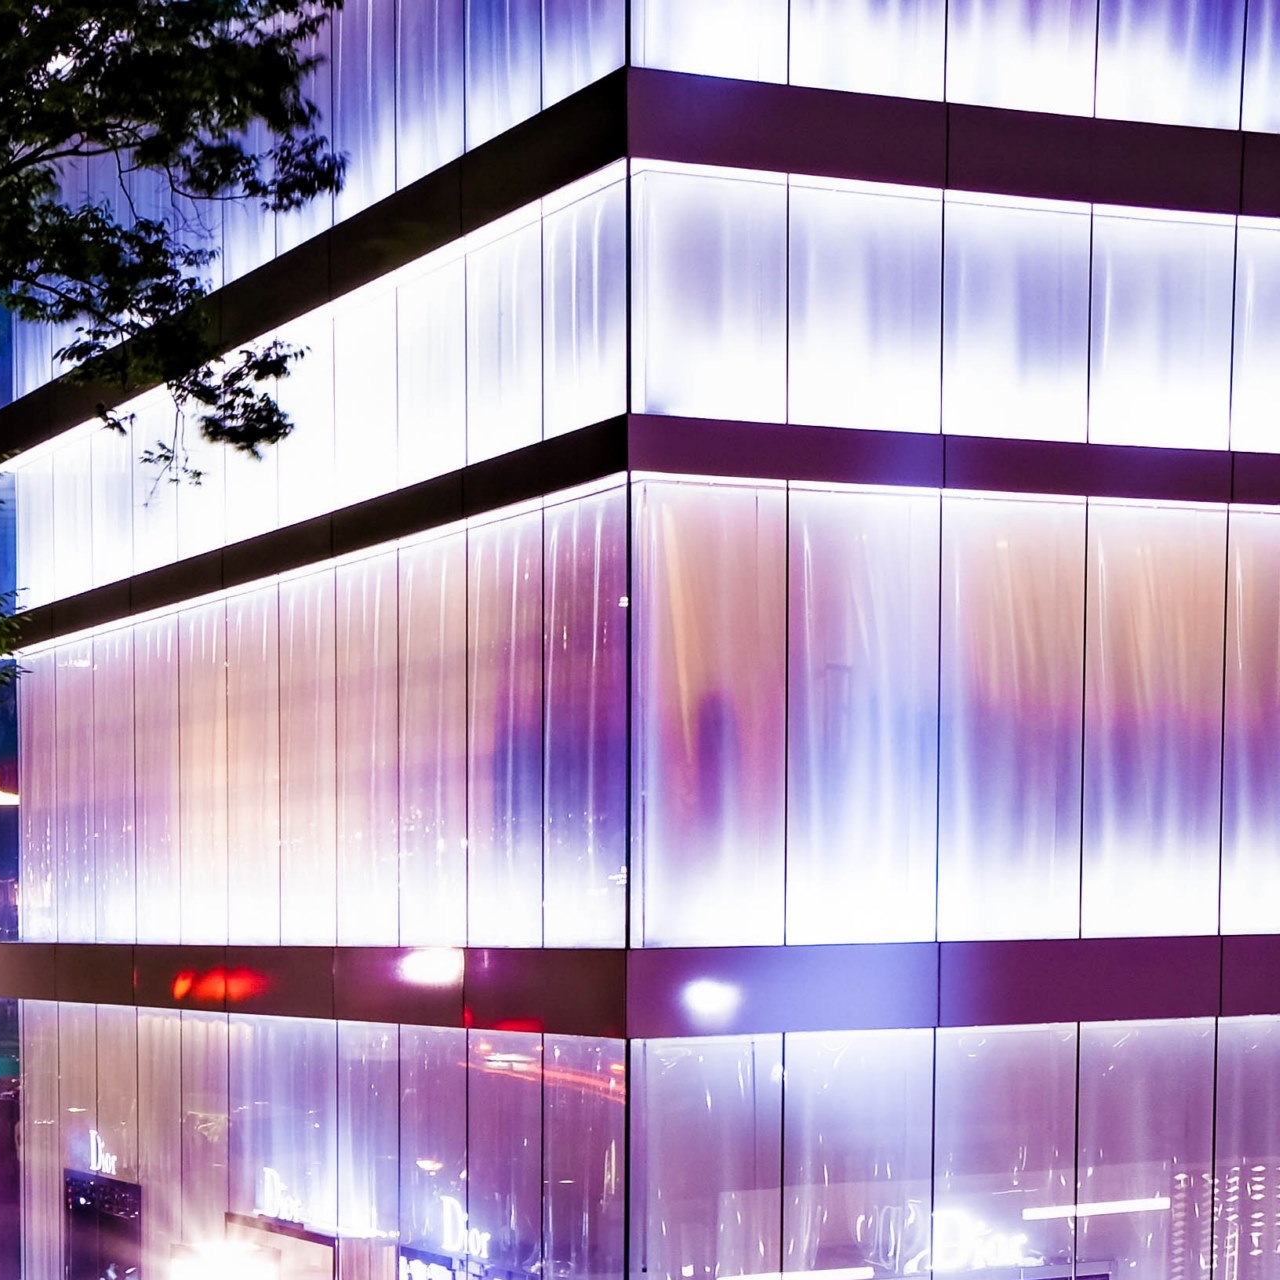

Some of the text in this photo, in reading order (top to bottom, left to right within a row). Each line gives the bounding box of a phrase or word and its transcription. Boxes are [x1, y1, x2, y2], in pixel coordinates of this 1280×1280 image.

[89, 1129, 117, 1175] Dior
[263, 1166, 303, 1224] Dior
[440, 1195, 491, 1259] Dior
[933, 1208, 1028, 1270] Dior
